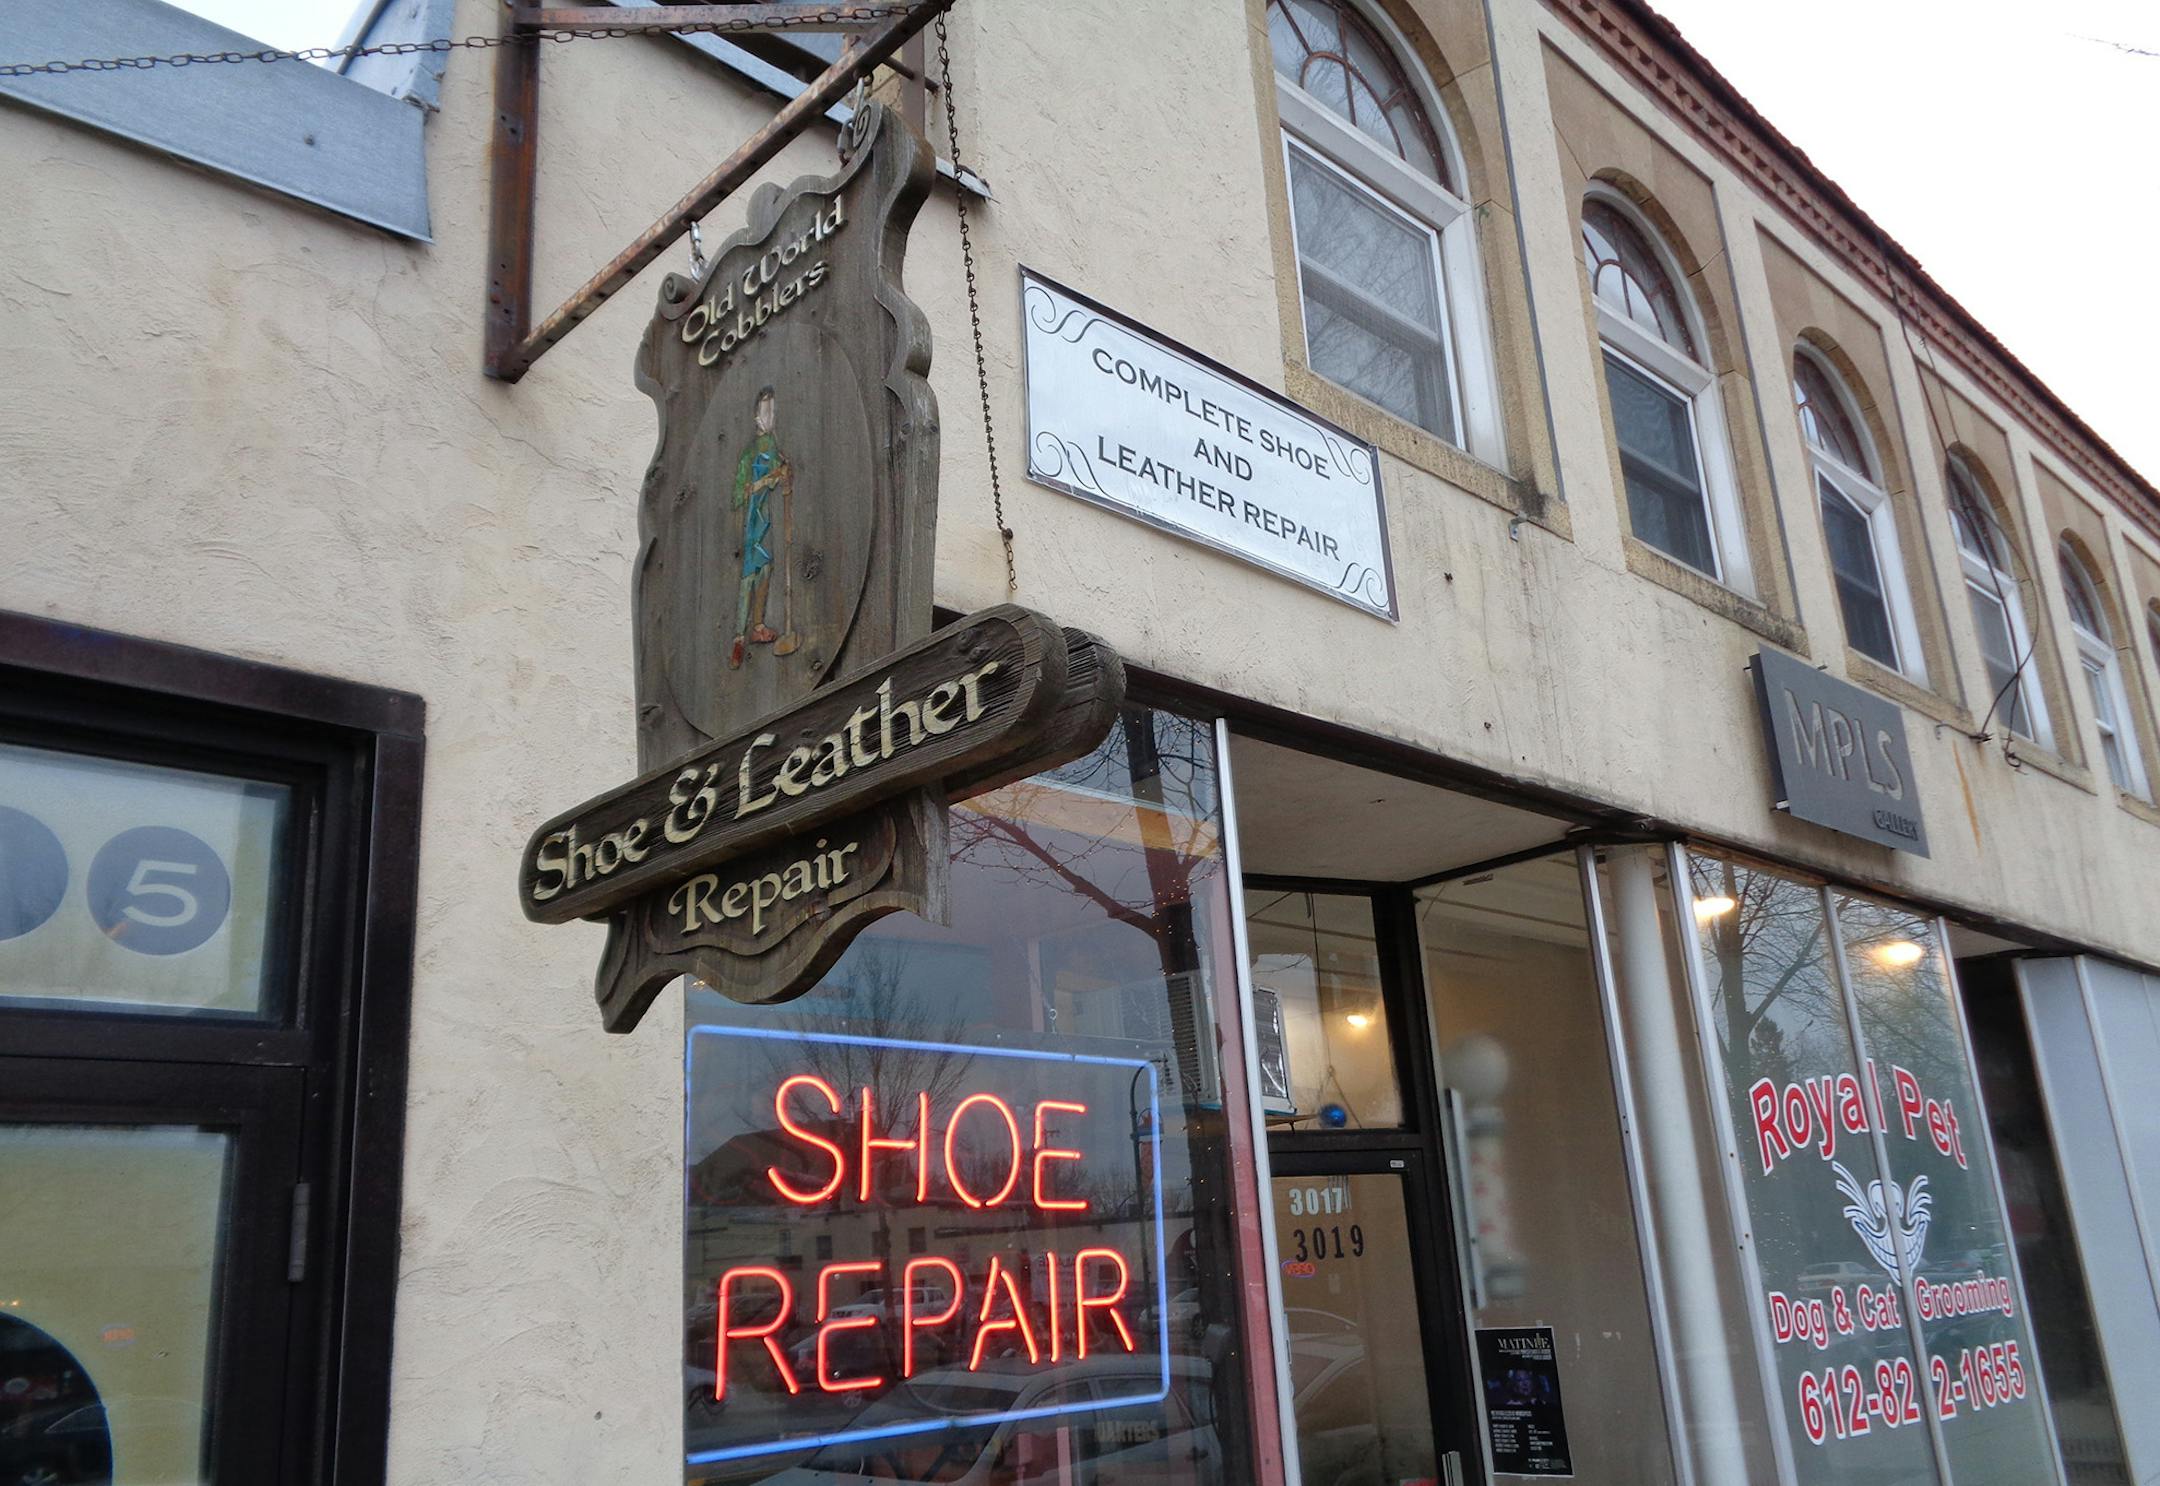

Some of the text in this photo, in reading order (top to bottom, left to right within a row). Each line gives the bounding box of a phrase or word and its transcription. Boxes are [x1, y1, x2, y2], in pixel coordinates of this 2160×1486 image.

[682, 195, 847, 344] Old World
[698, 259, 829, 367] Cobblers
[1092, 347, 1331, 480] COMPLETE SHOE
[1192, 438, 1253, 481] AND
[1098, 436, 1341, 562] LEATHER REPAIR
[533, 660, 1001, 901] Shoe & Leather
[1783, 688, 1904, 800] MPLS
[121, 859, 198, 928] 5
[668, 838, 859, 937] Repair
[767, 1075, 1087, 1210] SHOE
[1749, 1058, 1968, 1177] Royal Pet
[1288, 1187, 1342, 1216] 3017
[1293, 1224, 1364, 1263] 3019
[714, 1247, 1134, 1402] REPAIR
[1769, 1270, 2014, 1350] Dog & Cat Grooming
